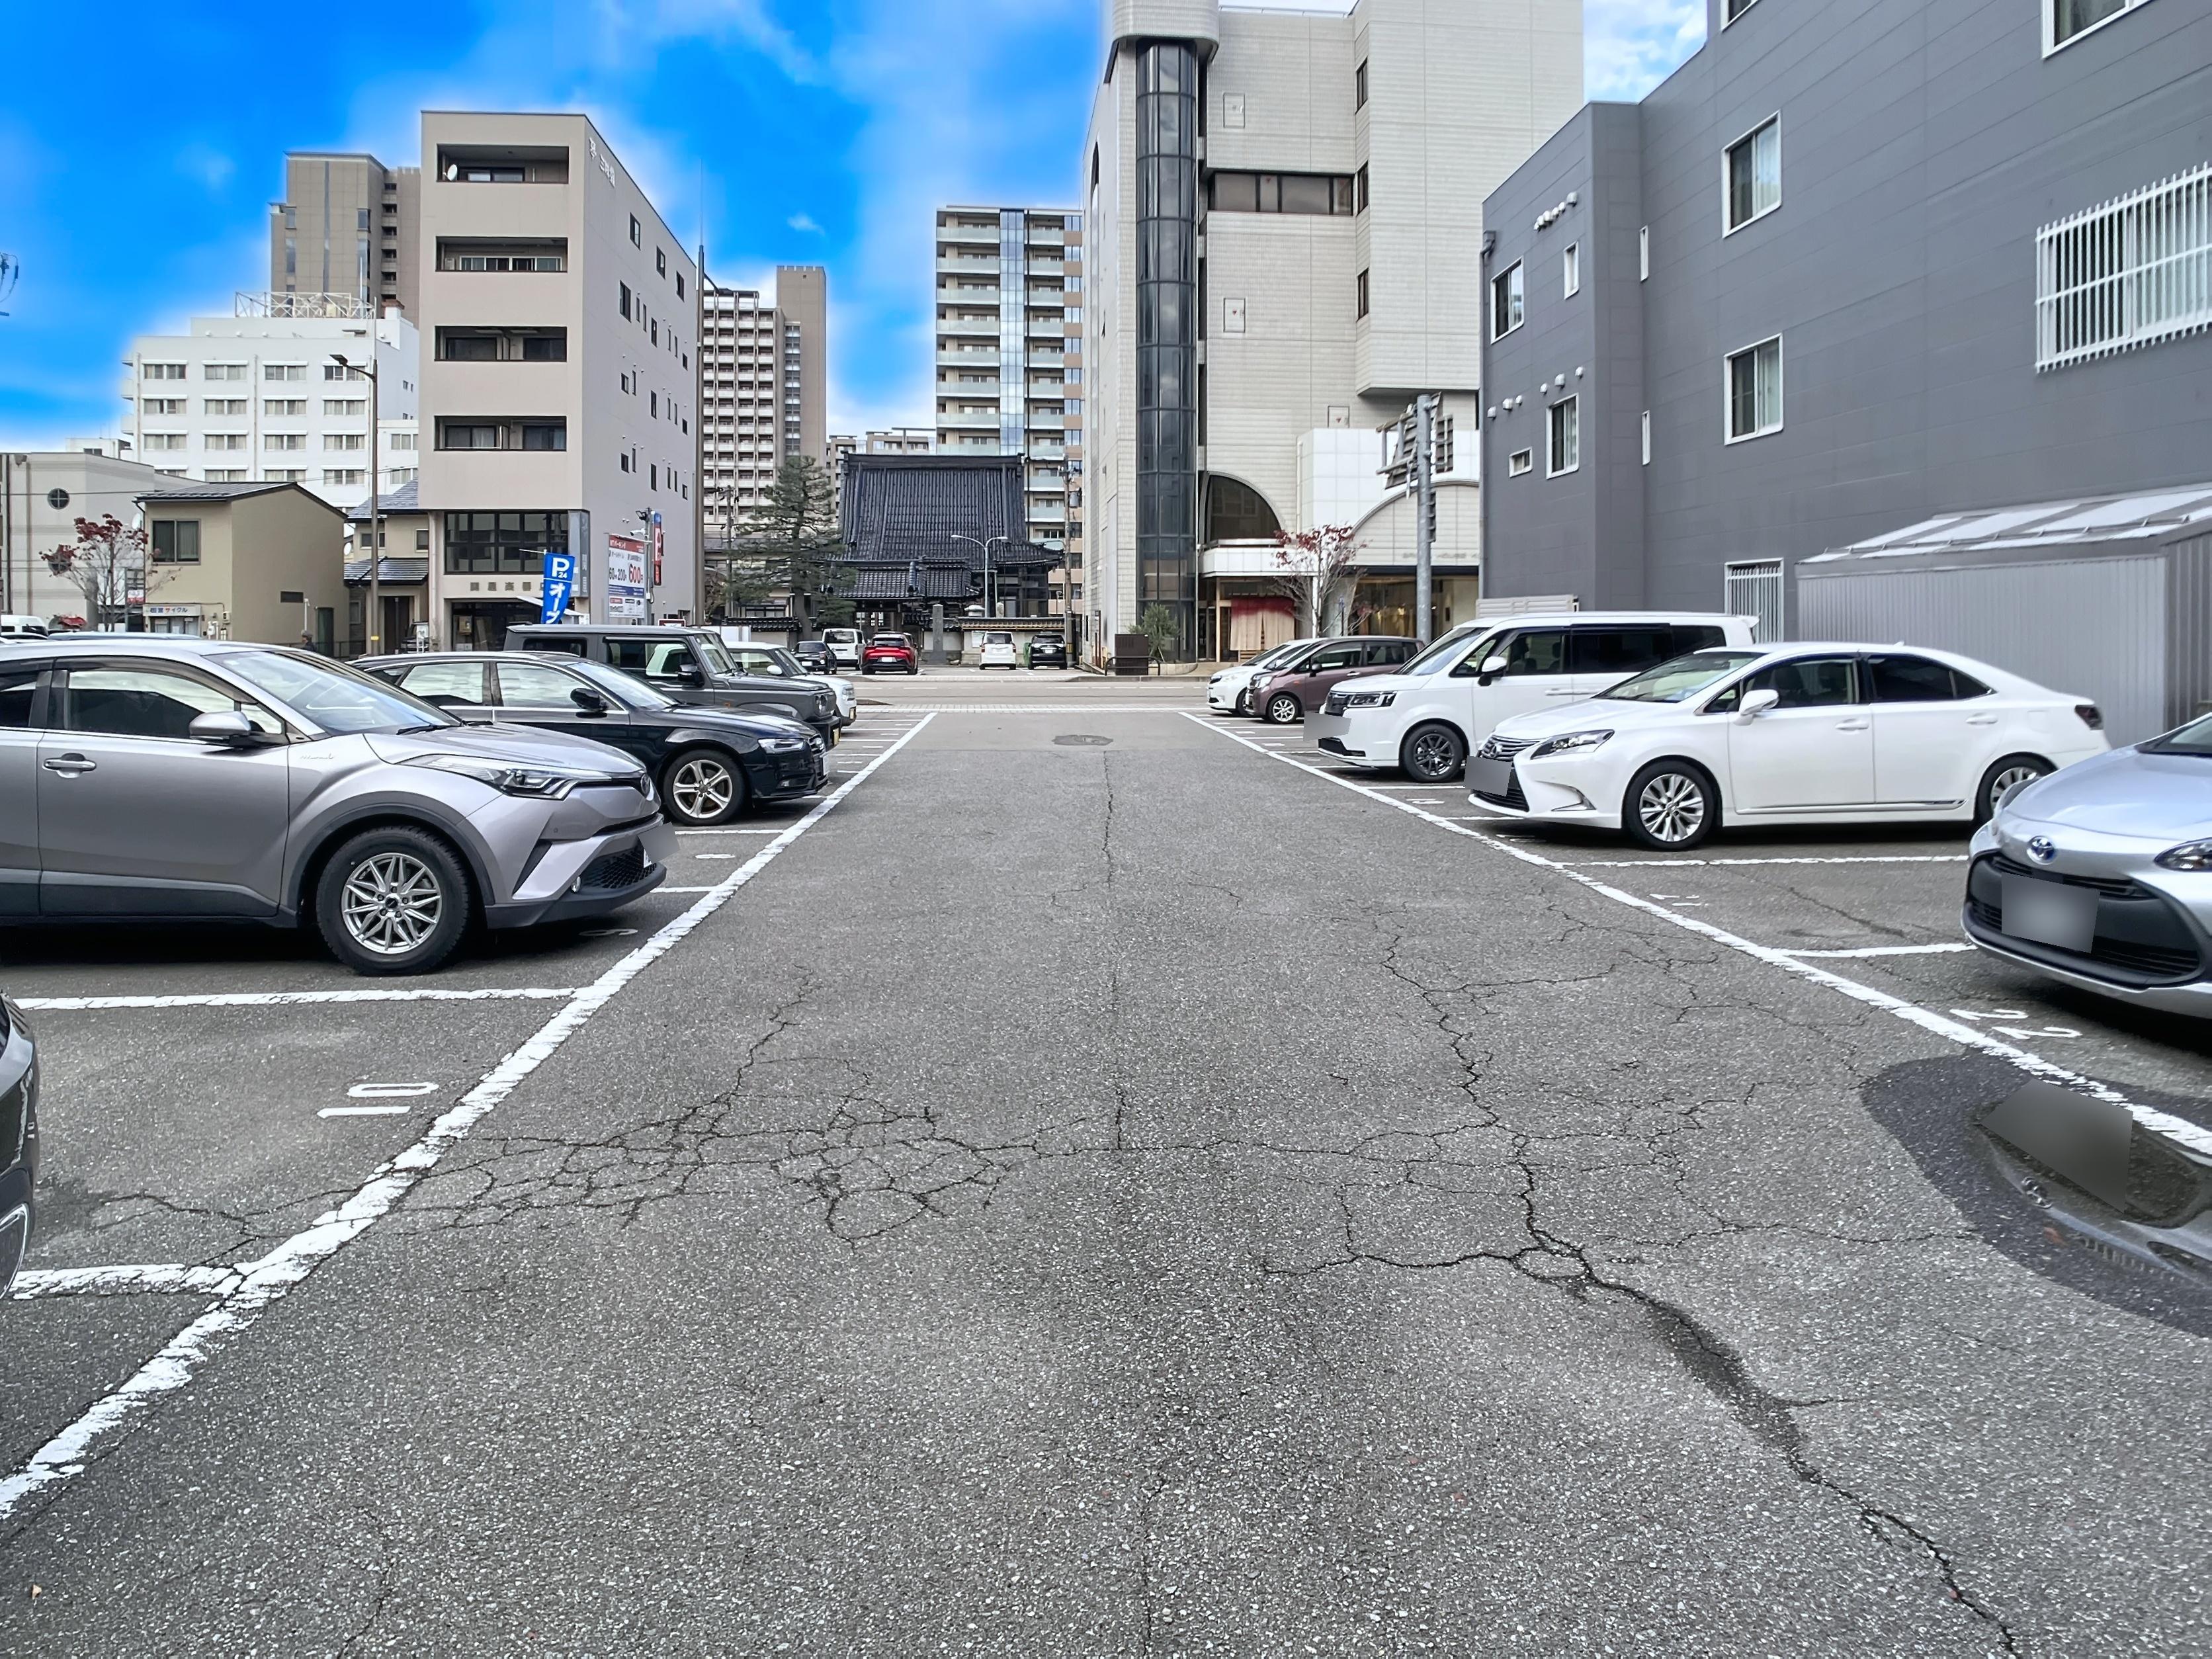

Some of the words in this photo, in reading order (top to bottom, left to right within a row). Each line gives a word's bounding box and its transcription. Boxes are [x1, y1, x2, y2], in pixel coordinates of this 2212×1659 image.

[552, 557, 570, 577] P
[1949, 1009, 2083, 1039] 22
[316, 1082, 439, 1119] 10
